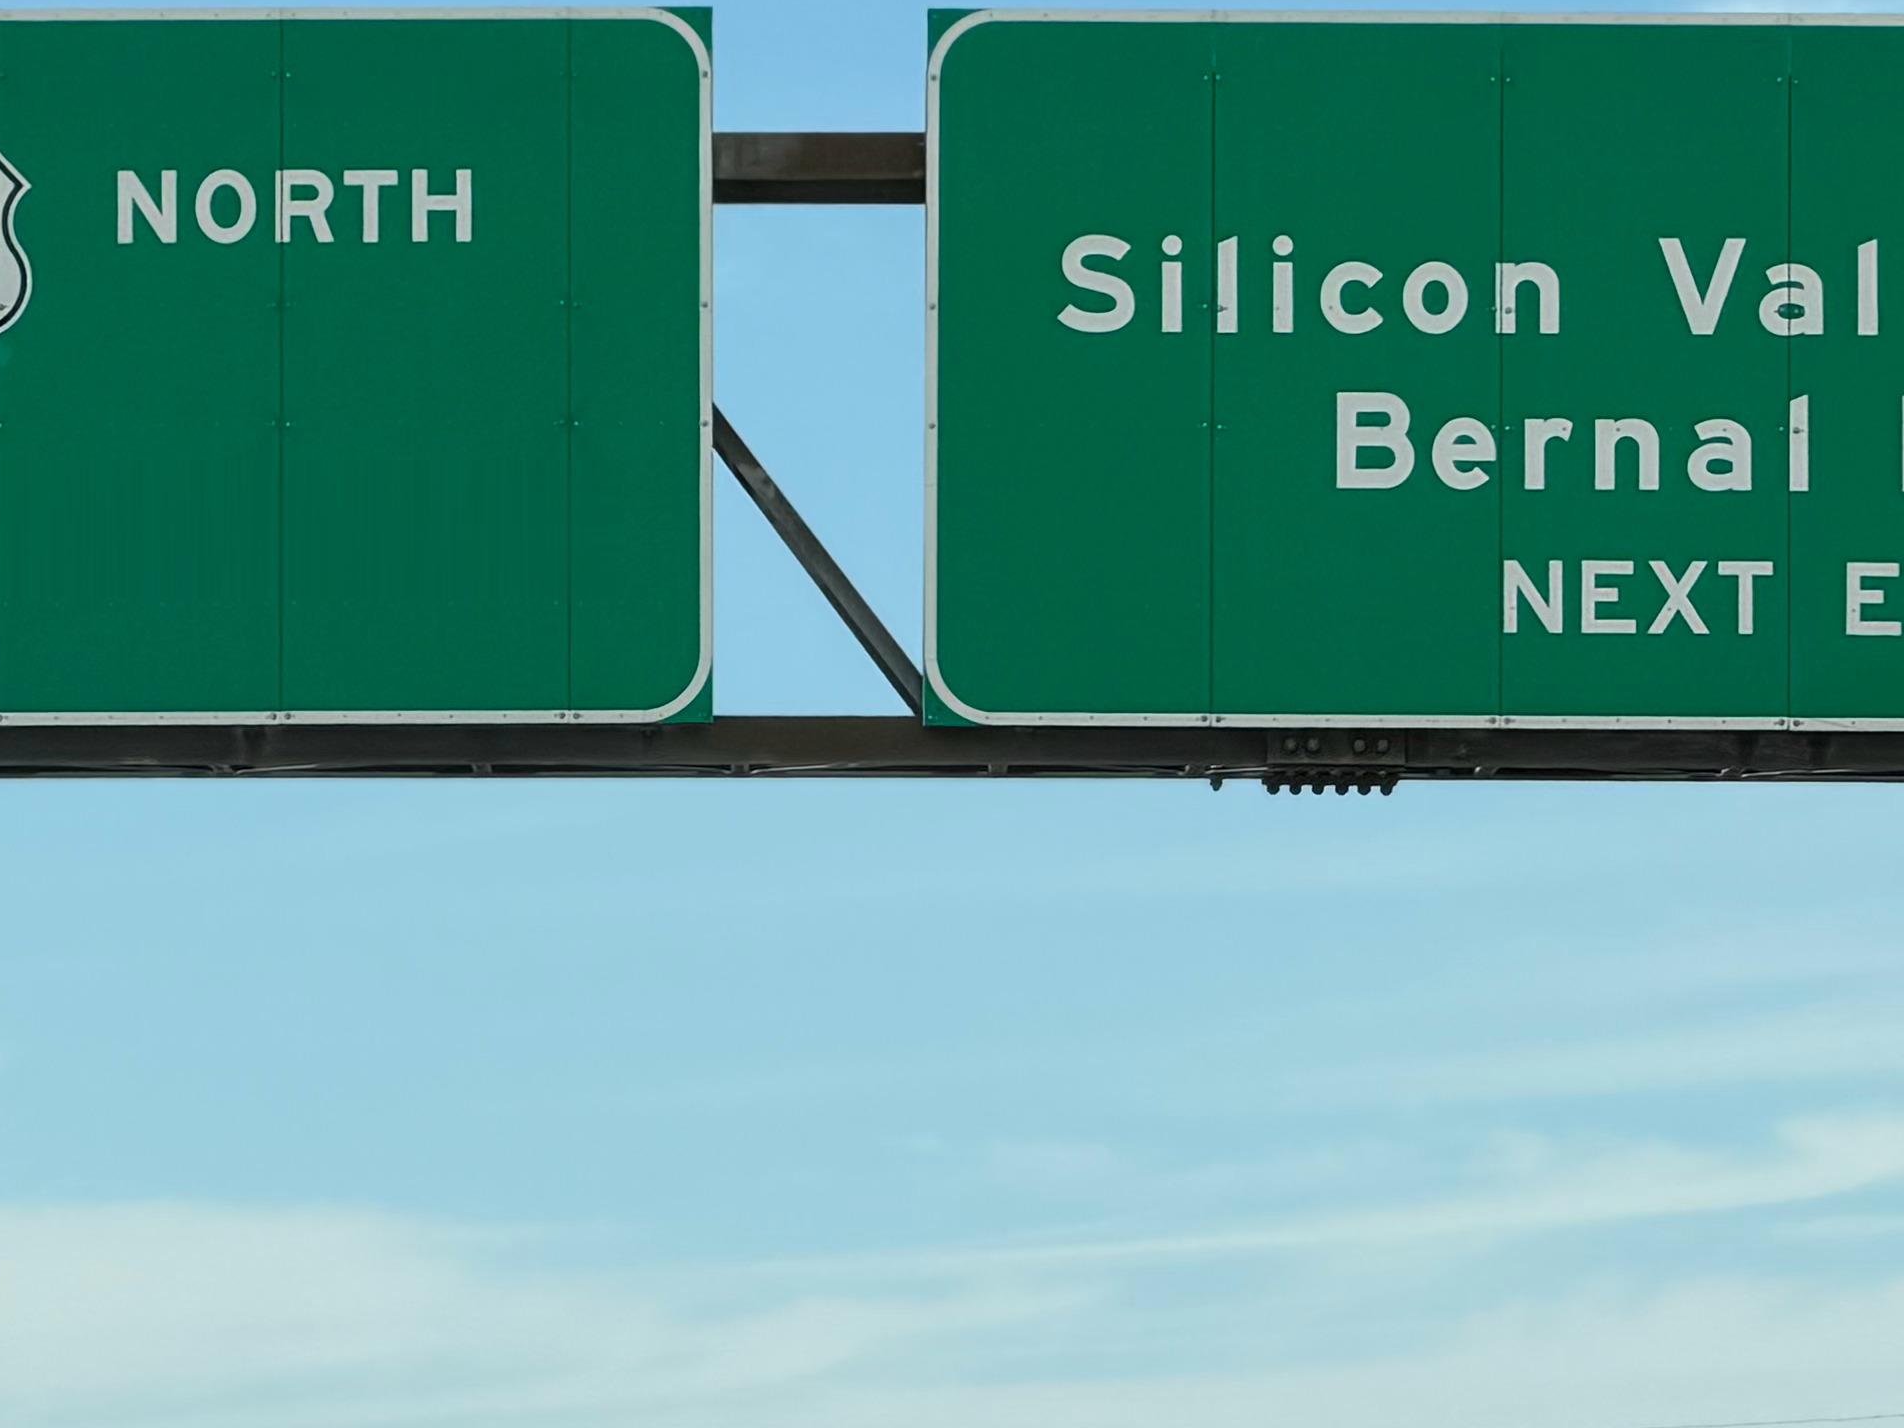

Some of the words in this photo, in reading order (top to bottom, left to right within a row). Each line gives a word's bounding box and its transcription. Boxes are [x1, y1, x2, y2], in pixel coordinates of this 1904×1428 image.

[116, 168, 474, 245] NORTH
[1057, 234, 1561, 336] Silicon
[1336, 391, 1810, 493] Bernal
[1503, 559, 1775, 635] NEXT
